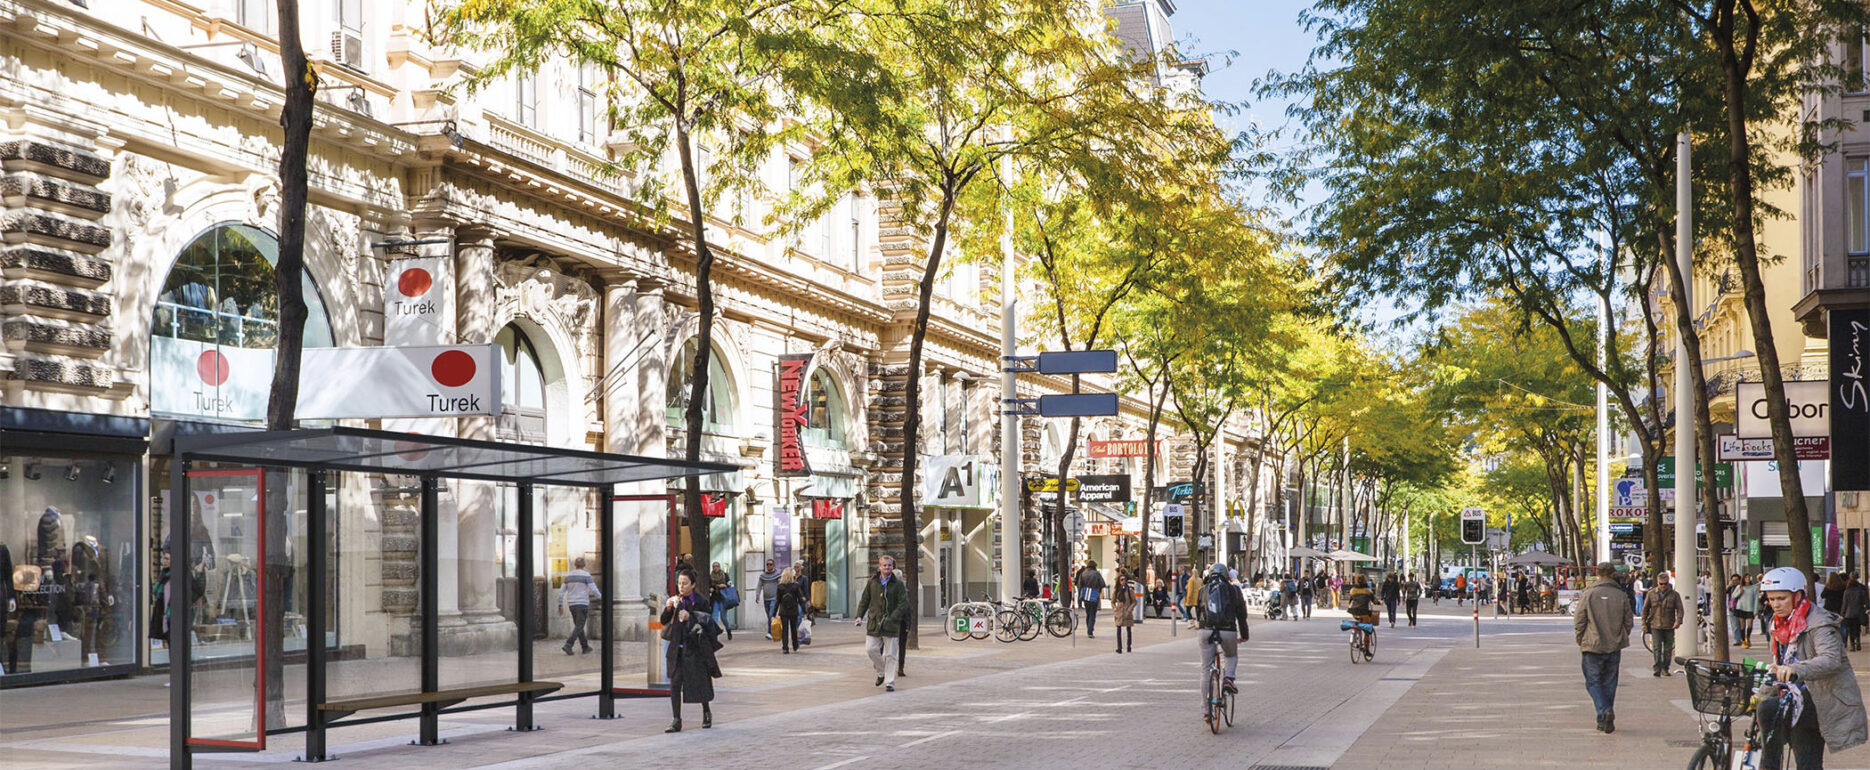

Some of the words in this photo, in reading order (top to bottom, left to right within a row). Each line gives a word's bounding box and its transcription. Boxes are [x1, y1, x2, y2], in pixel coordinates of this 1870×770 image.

[395, 300, 435, 315] Turek
[1840, 321, 1868, 413] Skiny
[193, 391, 233, 413] Turek
[426, 394, 480, 412] Turek
[1107, 443, 1158, 455] BORTOLOTI
[1080, 483, 1119, 492] American
[1080, 491, 1112, 501] Apparel
[23, 584, 65, 595] ECTION
[956, 619, 967, 631] P
